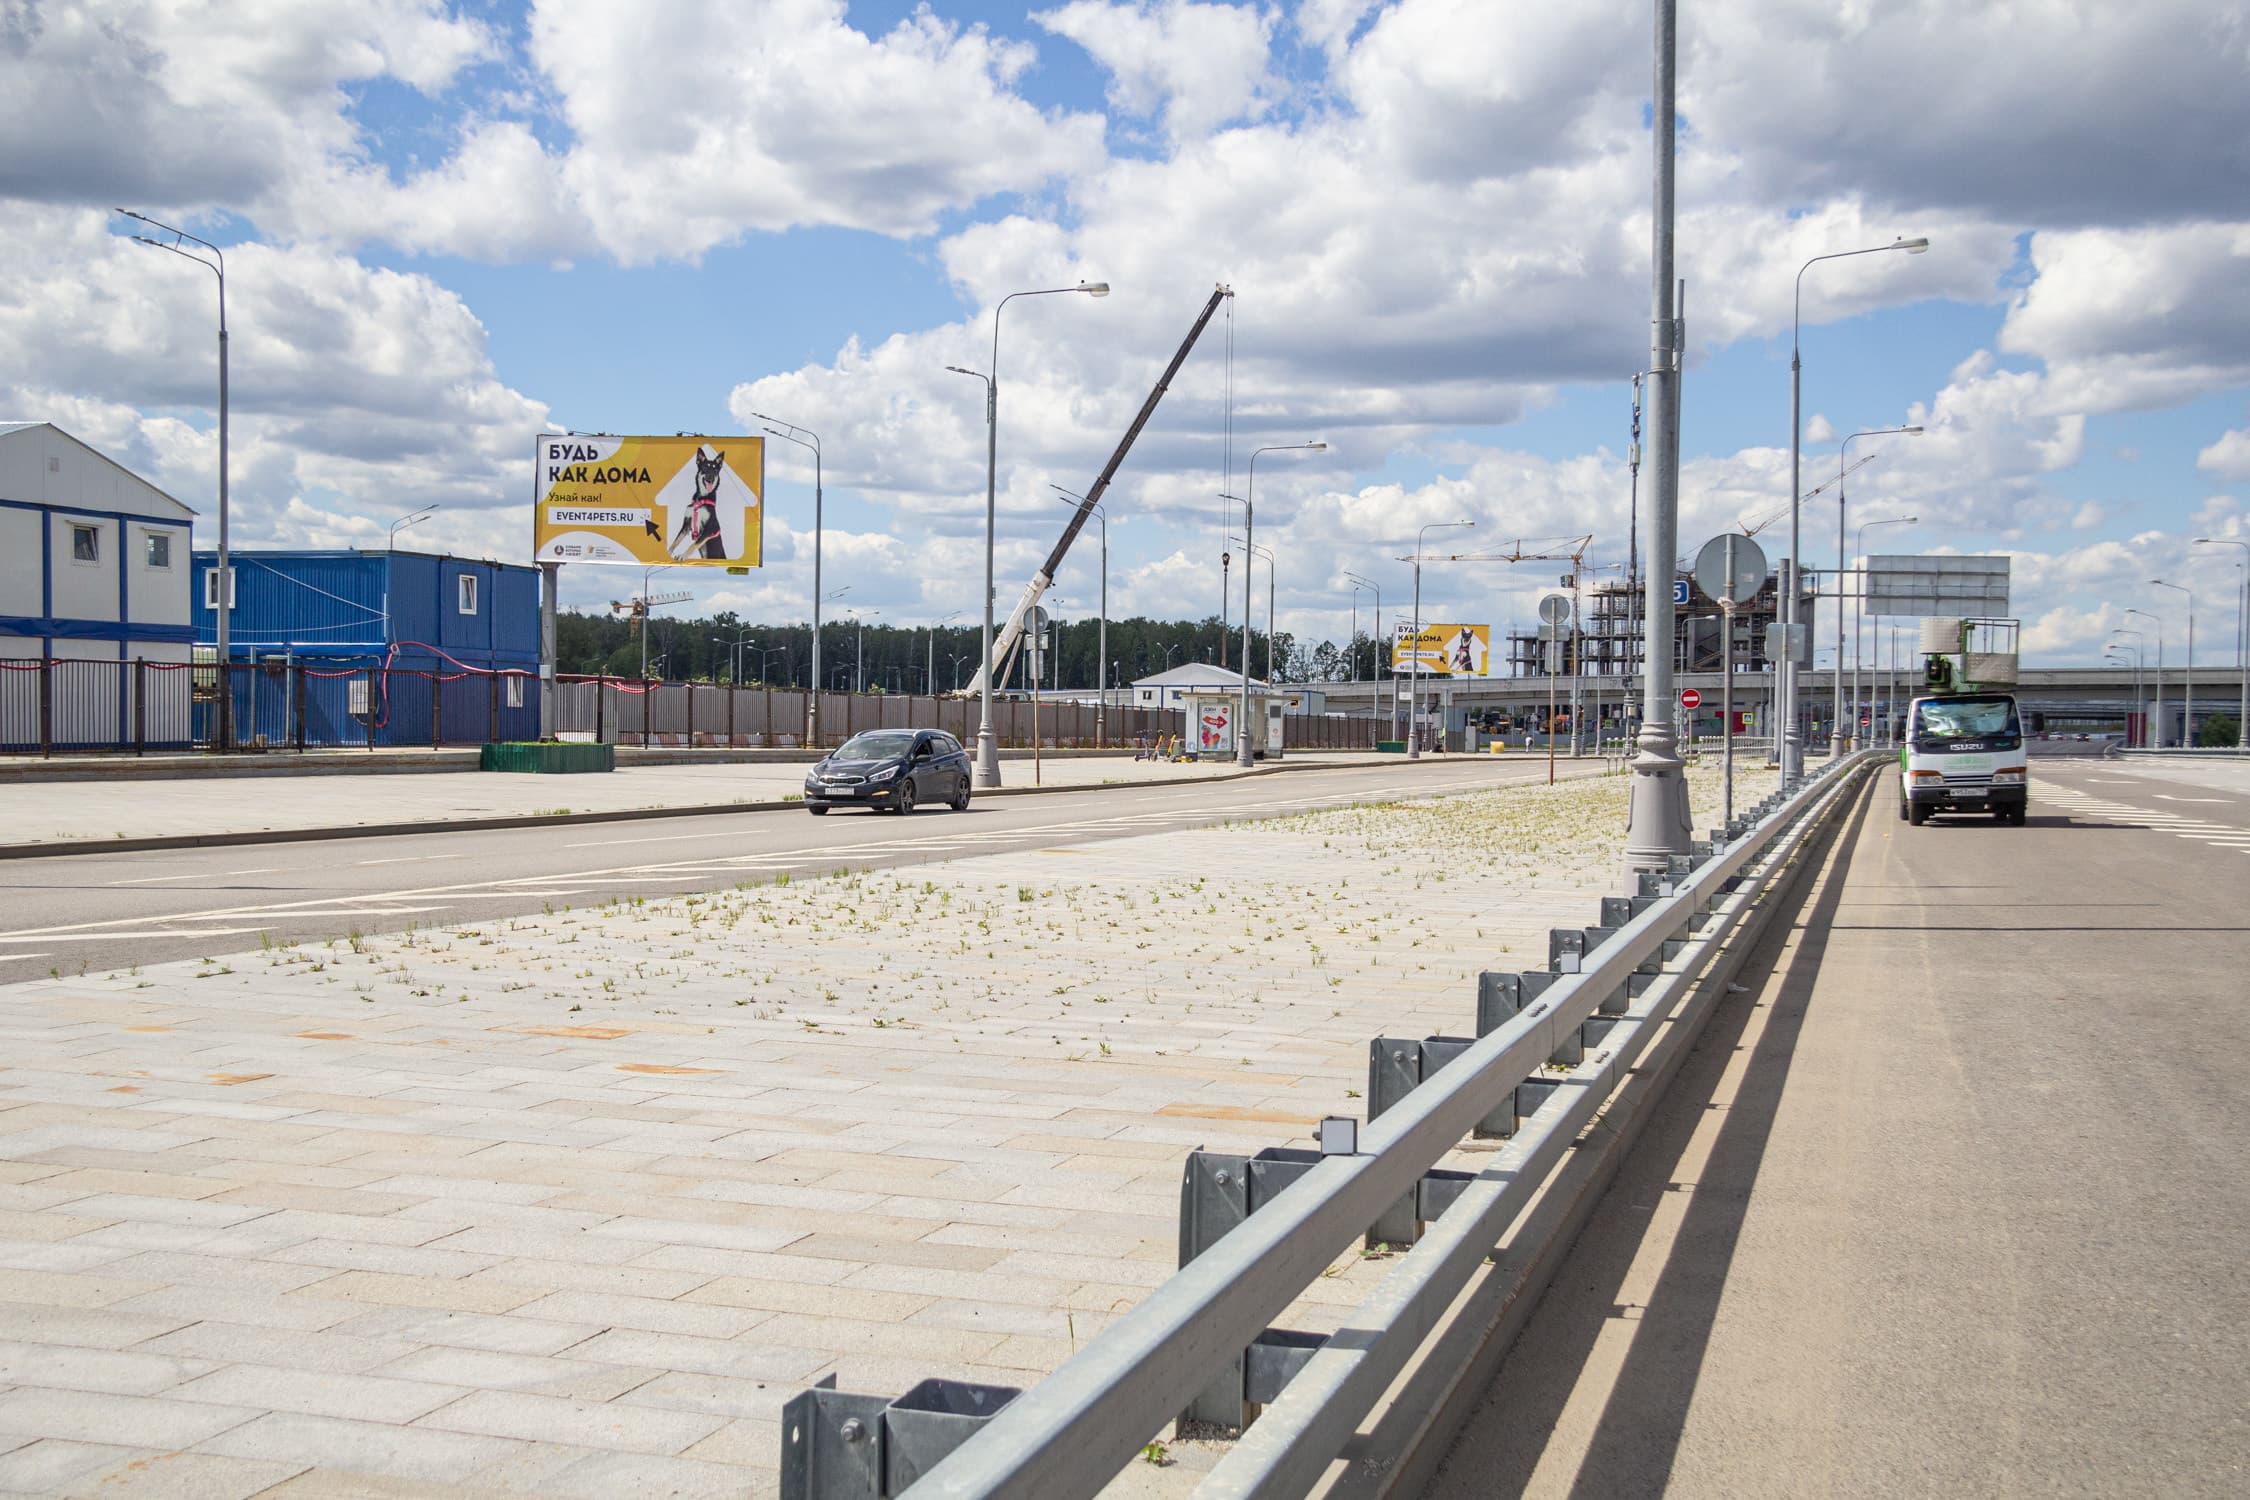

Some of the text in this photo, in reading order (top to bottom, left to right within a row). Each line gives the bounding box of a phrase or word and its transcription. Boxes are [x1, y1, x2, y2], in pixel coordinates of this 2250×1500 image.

[549, 444, 598, 461] БУДЬ
[549, 466, 652, 485] КАК ДОМА
[548, 492, 602, 502] Узнай как!
[556, 511, 634, 522] EVENT4PETS.RU
